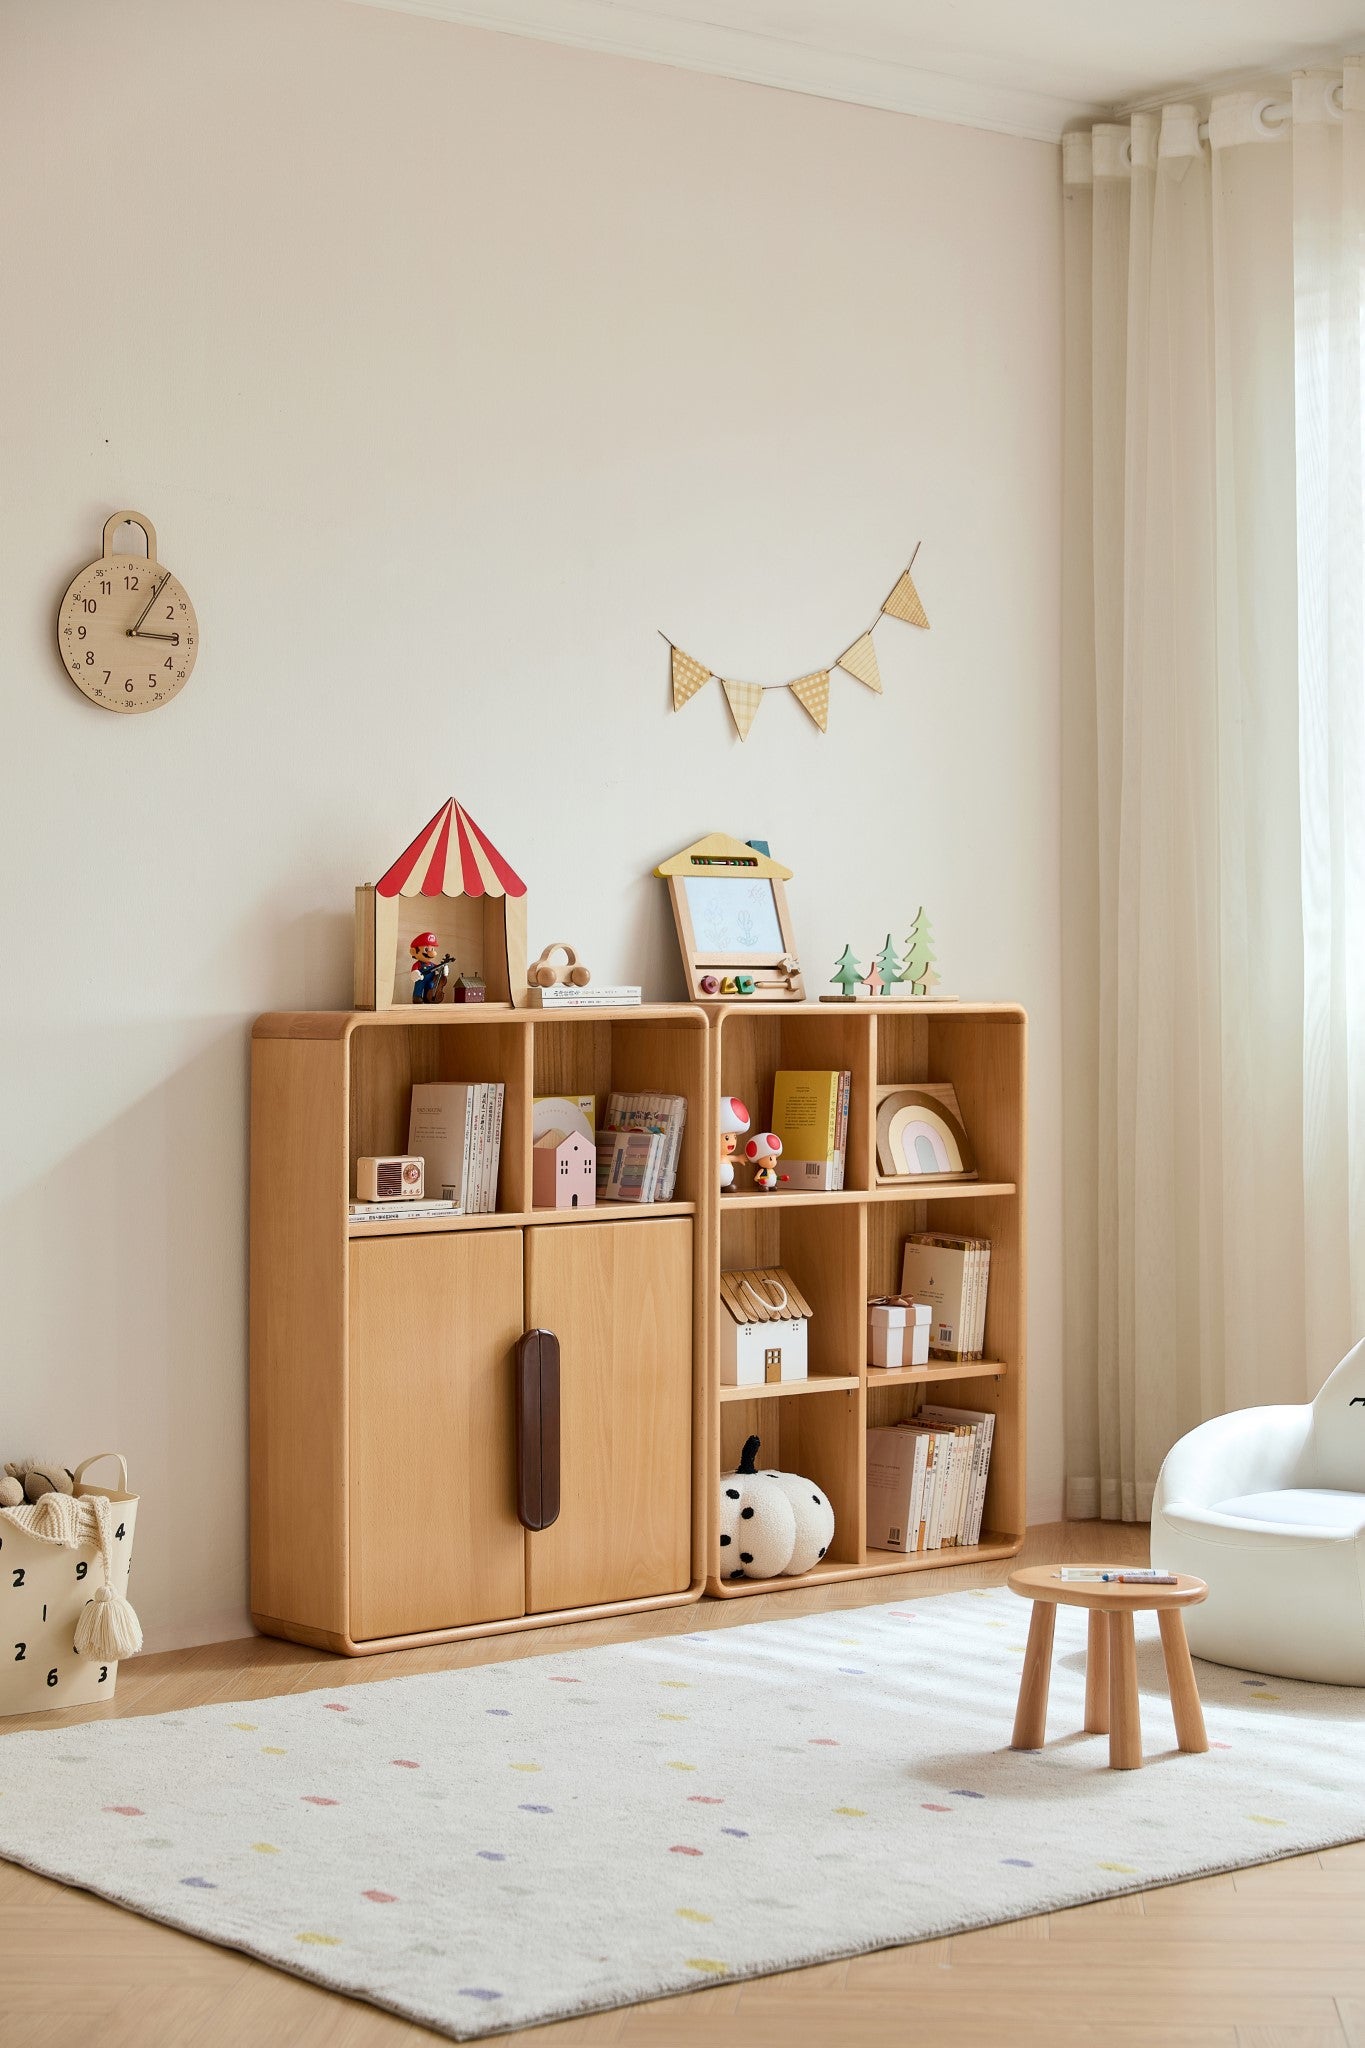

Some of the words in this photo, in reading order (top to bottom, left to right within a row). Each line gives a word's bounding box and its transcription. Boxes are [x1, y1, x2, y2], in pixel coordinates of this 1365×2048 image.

[95, 569, 104, 577] 55
[100, 581, 111, 595] 11
[124, 577, 138, 590] 12
[72, 593, 82, 601] 50
[151, 585, 157, 597] 1
[82, 599, 96, 613] 10
[166, 606, 174, 619] 2
[179, 602, 187, 611] 10
[63, 627, 73, 636] 45
[78, 626, 86, 639] 9
[171, 633, 179, 646] 3
[186, 637, 194, 645] 15
[86, 651, 94, 665] 8
[164, 657, 173, 670] 4
[71, 662, 81, 670] 40
[103, 671, 111, 684] 7
[149, 674, 157, 687] 5
[176, 670, 186, 678] 20
[125, 679, 133, 692] 6
[94, 688, 103, 697] 35
[154, 692, 163, 701] 25
[124, 700, 134, 708] 30
[115, 1523, 125, 1541] 4
[76, 1562, 87, 1580] 9
[12, 1569, 25, 1587] 2
[14, 1643, 26, 1661] 2
[47, 1669, 58, 1687] 6
[98, 1666, 107, 1683] 3
